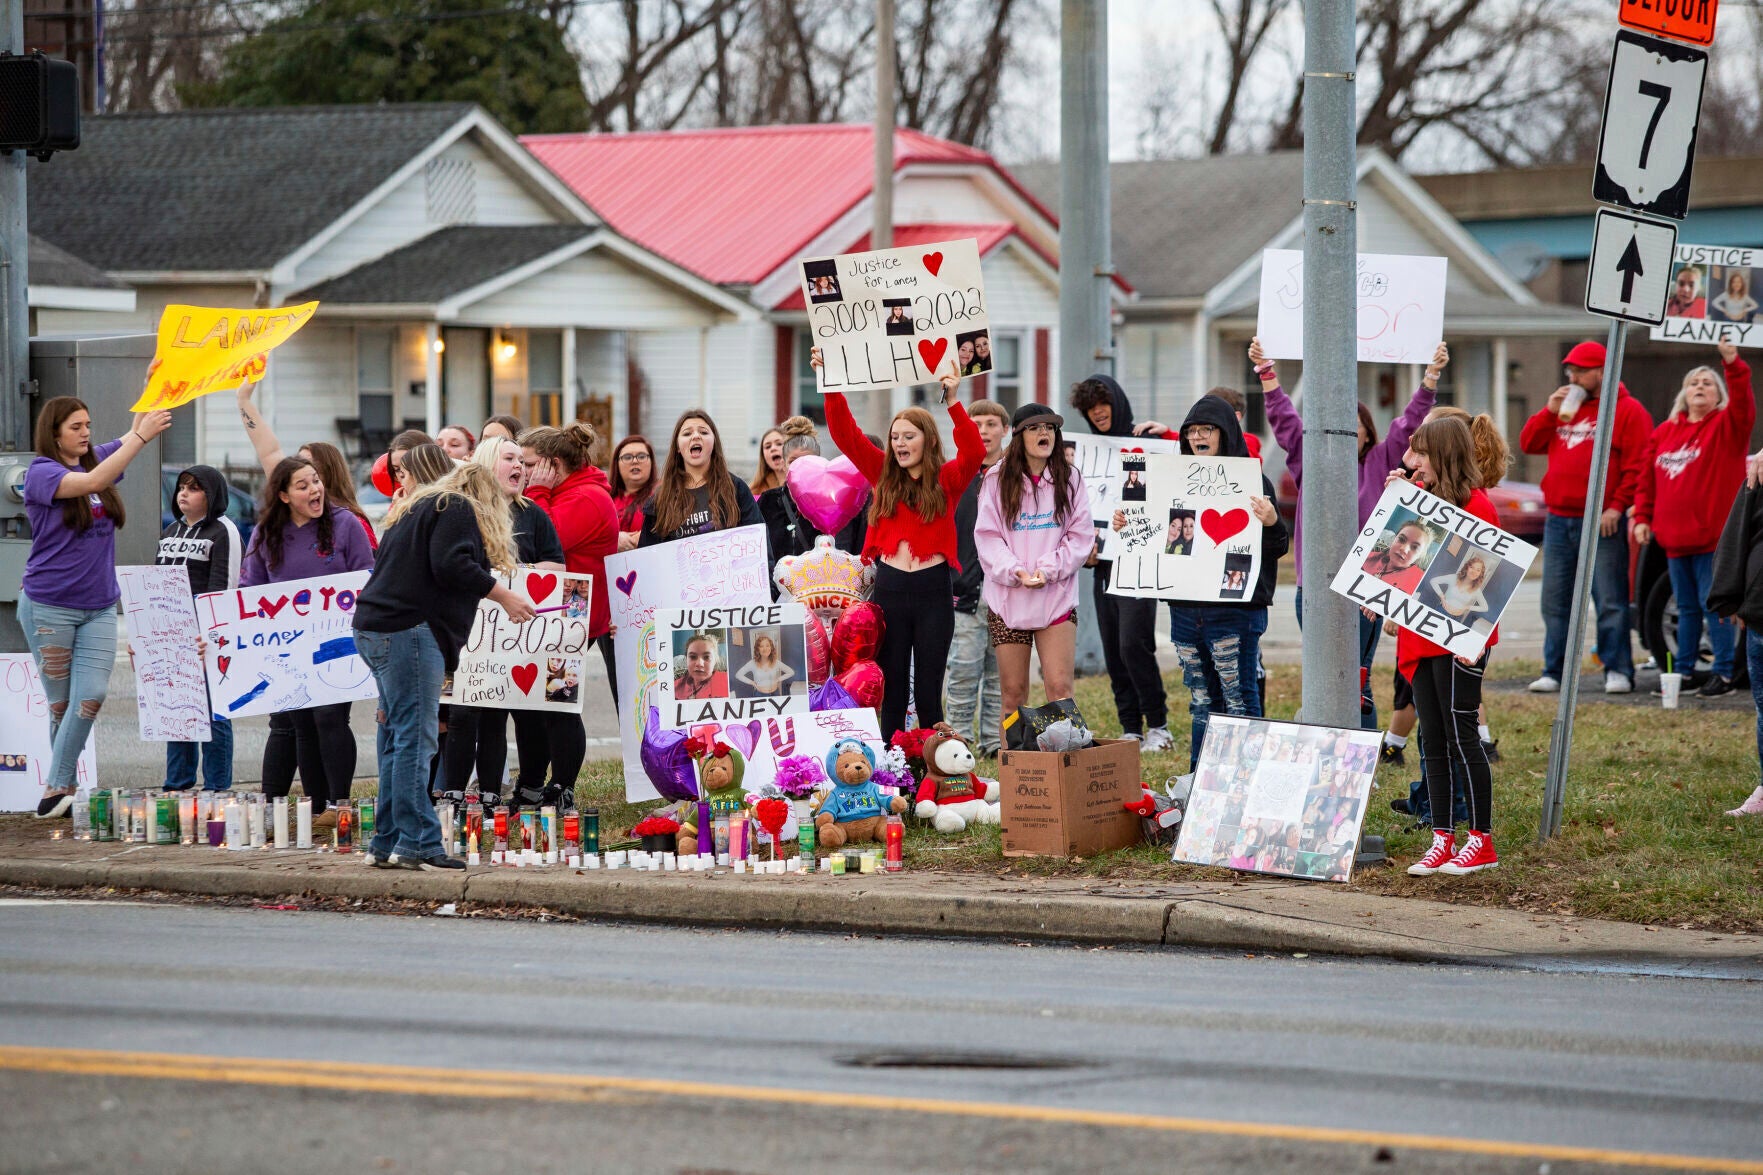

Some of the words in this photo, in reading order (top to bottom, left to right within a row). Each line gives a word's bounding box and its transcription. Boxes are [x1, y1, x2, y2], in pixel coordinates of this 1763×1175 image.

[1638, 79, 1672, 170] 7
[849, 257, 902, 277] Justice
[864, 276, 883, 288] for
[886, 275, 918, 289] Laney
[170, 308, 313, 349] LANEY
[814, 299, 880, 337] 2009
[915, 287, 985, 331] 2022
[1663, 320, 1753, 343] LANEY
[821, 340, 919, 388] LLLH
[1353, 508, 1386, 557] FOR
[1400, 490, 1515, 556] JUSTICE
[1116, 552, 1174, 591] LLL
[319, 585, 362, 612] Yo
[670, 605, 782, 629] JUSTICE
[1346, 573, 1471, 647] LANEY
[237, 630, 305, 650] Laney
[460, 659, 507, 675] Justice
[468, 676, 485, 687] for
[658, 641, 669, 692] FOR
[462, 677, 511, 703] Laney!
[766, 716, 796, 758] U
